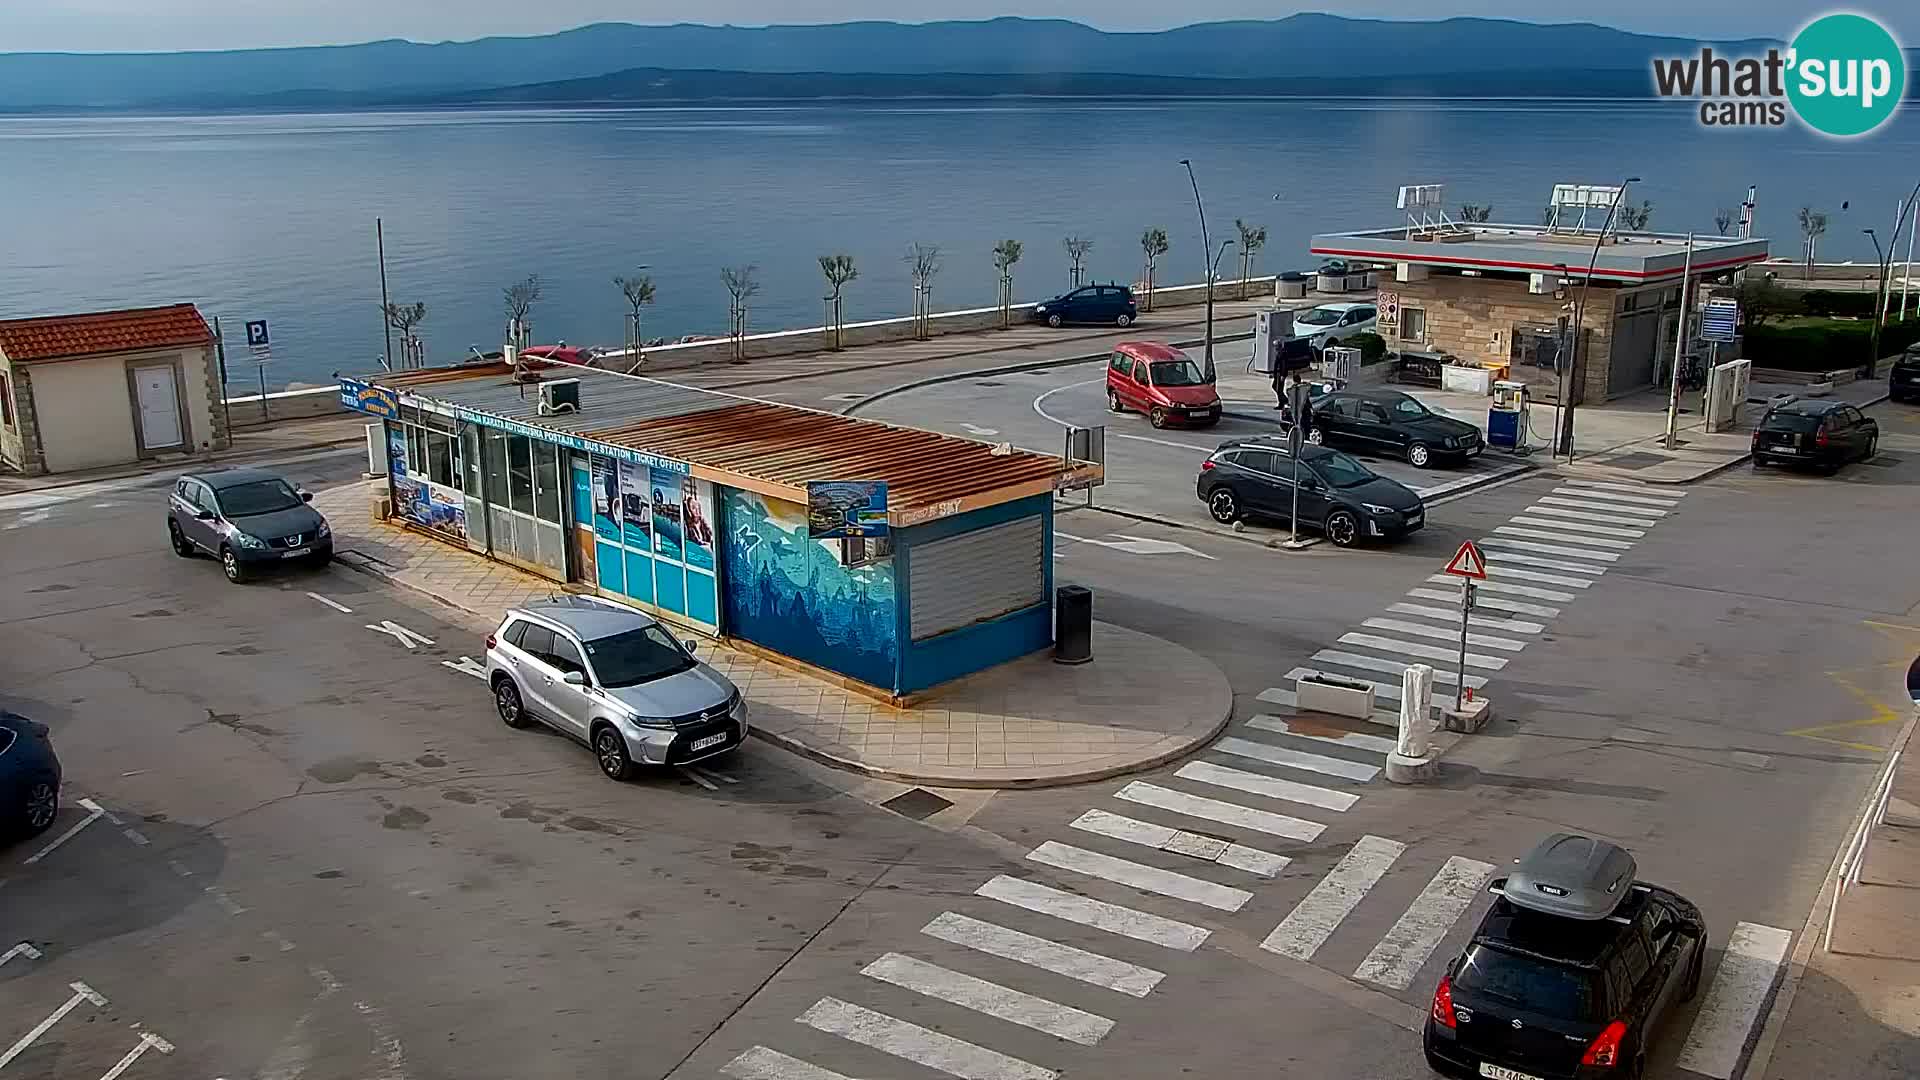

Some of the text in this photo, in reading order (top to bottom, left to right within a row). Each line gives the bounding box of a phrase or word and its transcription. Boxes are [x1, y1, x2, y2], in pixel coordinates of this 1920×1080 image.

[251, 324, 263, 342] P
[544, 431, 575, 446] POSTAJA
[584, 440, 599, 452] BUS
[599, 445, 631, 461] STATION
[633, 452, 658, 467] TICKET
[659, 458, 686, 473] OFFICE
[1487, 1065, 1499, 1077] ST
